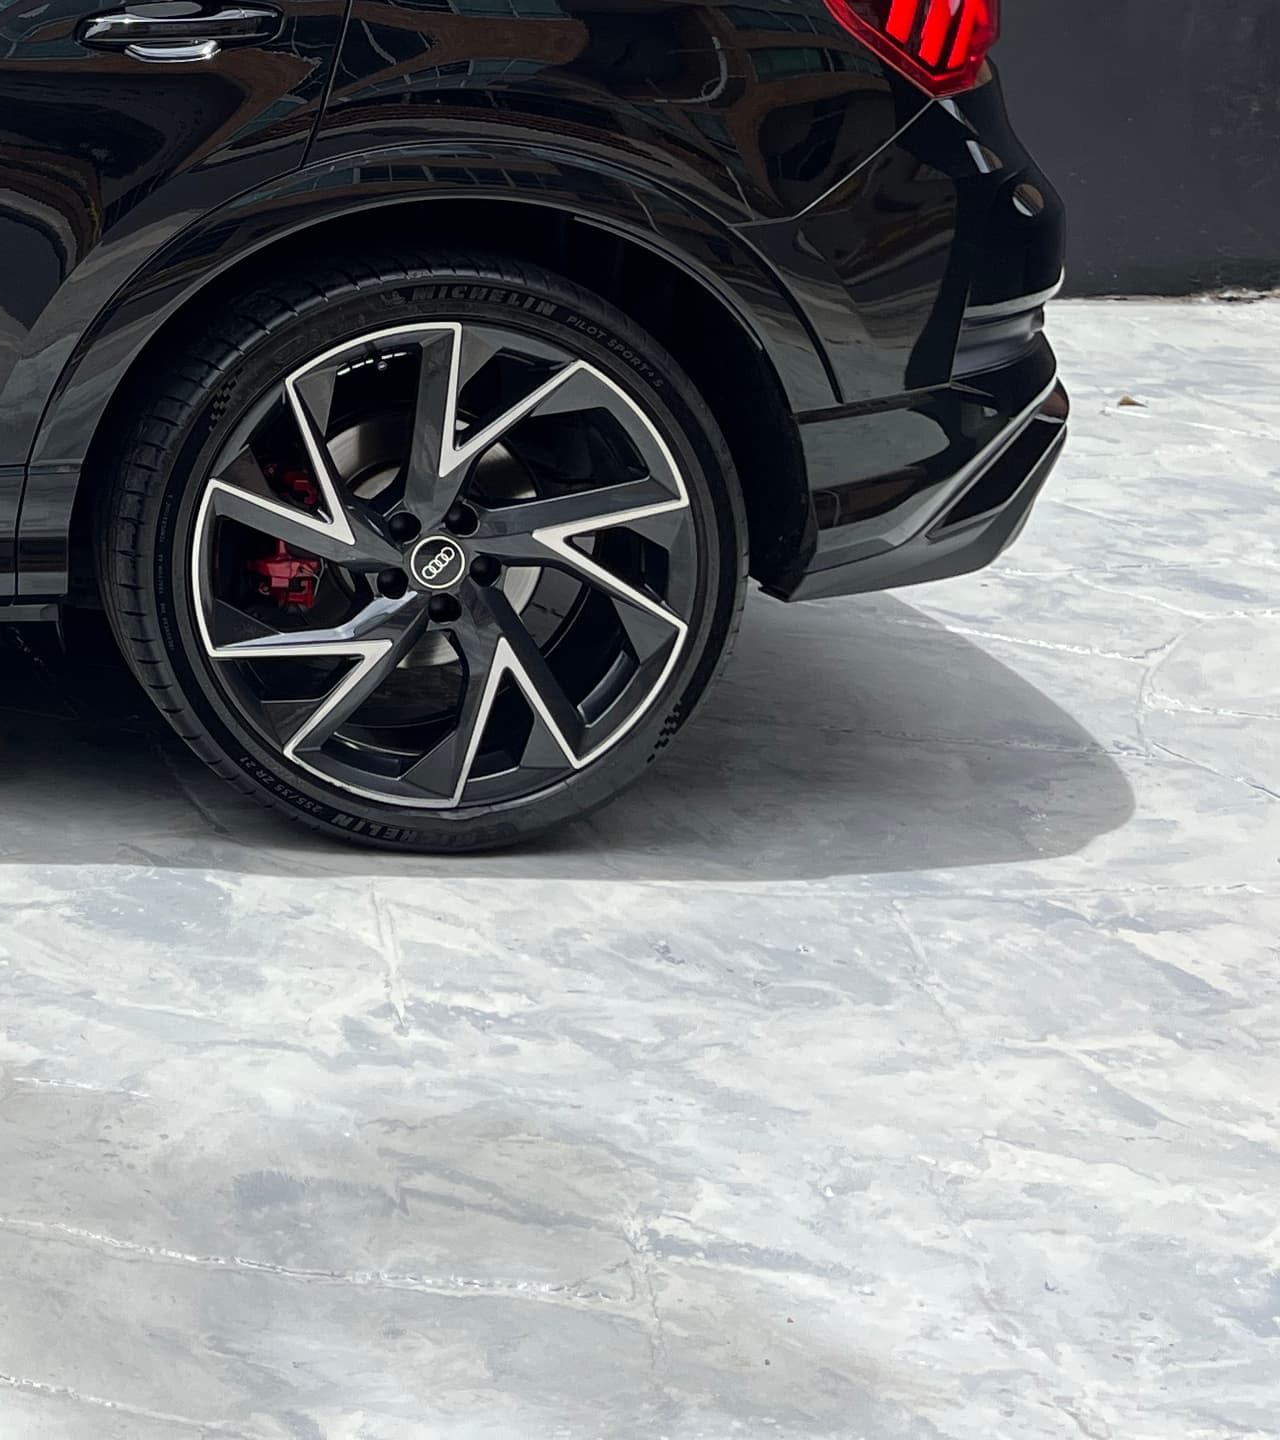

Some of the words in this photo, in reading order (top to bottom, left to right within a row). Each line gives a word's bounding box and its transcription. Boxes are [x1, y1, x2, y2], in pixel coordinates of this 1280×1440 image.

[410, 285, 559, 317] MICHELIN
[566, 314, 608, 339] PILOT
[239, 756, 257, 768] 21
[255, 769, 276, 785] ZR
[273, 784, 323, 814] 255/35
